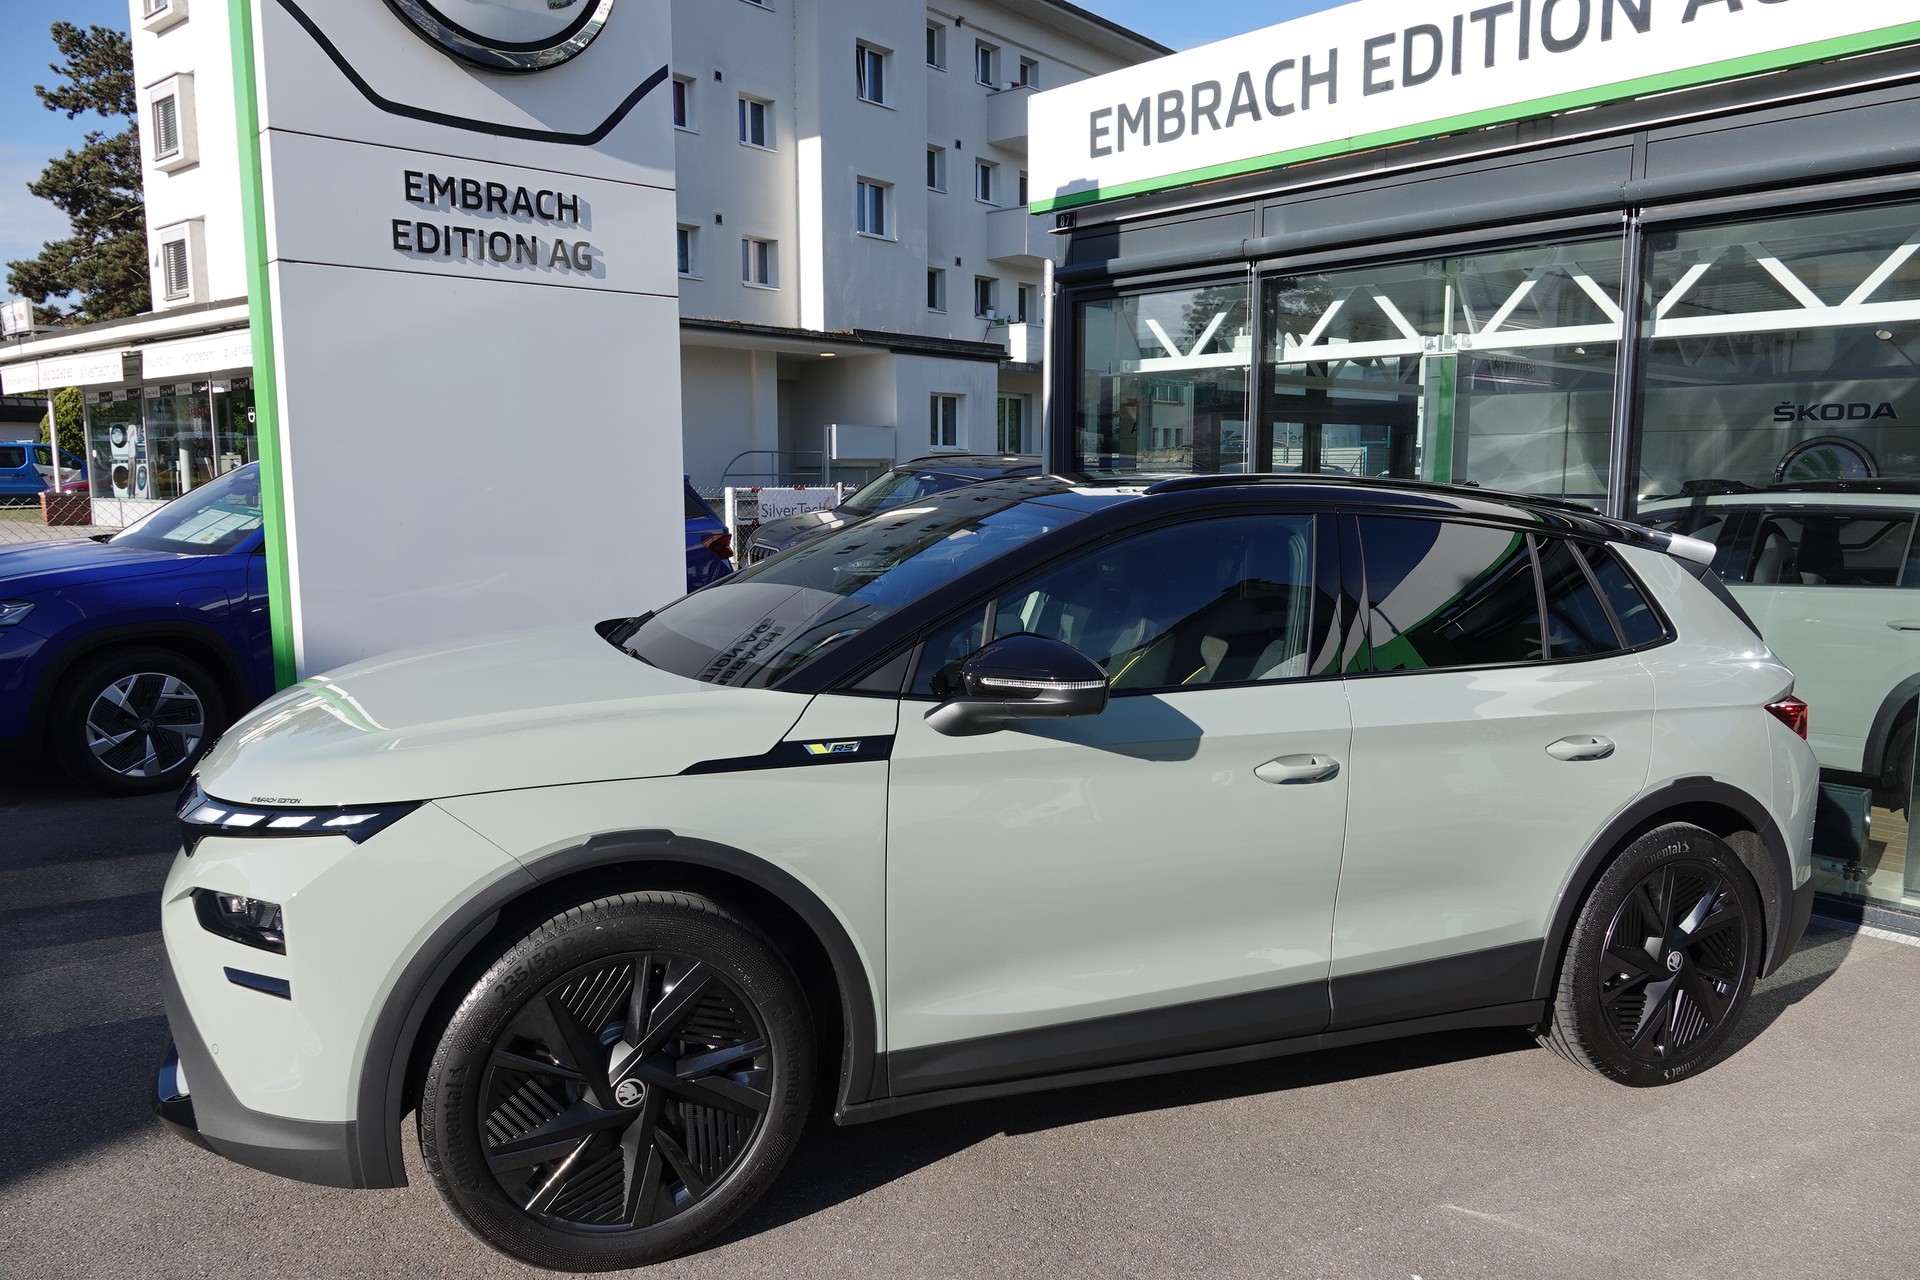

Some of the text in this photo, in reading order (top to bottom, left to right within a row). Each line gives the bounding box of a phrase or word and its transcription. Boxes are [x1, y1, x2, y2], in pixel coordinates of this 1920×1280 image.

[1090, 0, 1651, 158] EMBRACH EDITION
[404, 170, 579, 223] EMBRACH
[1060, 214, 1071, 227] 87
[392, 218, 593, 271] EDITION AG
[1773, 401, 1898, 421] ŠKODA
[495, 945, 560, 1000] 235/50
